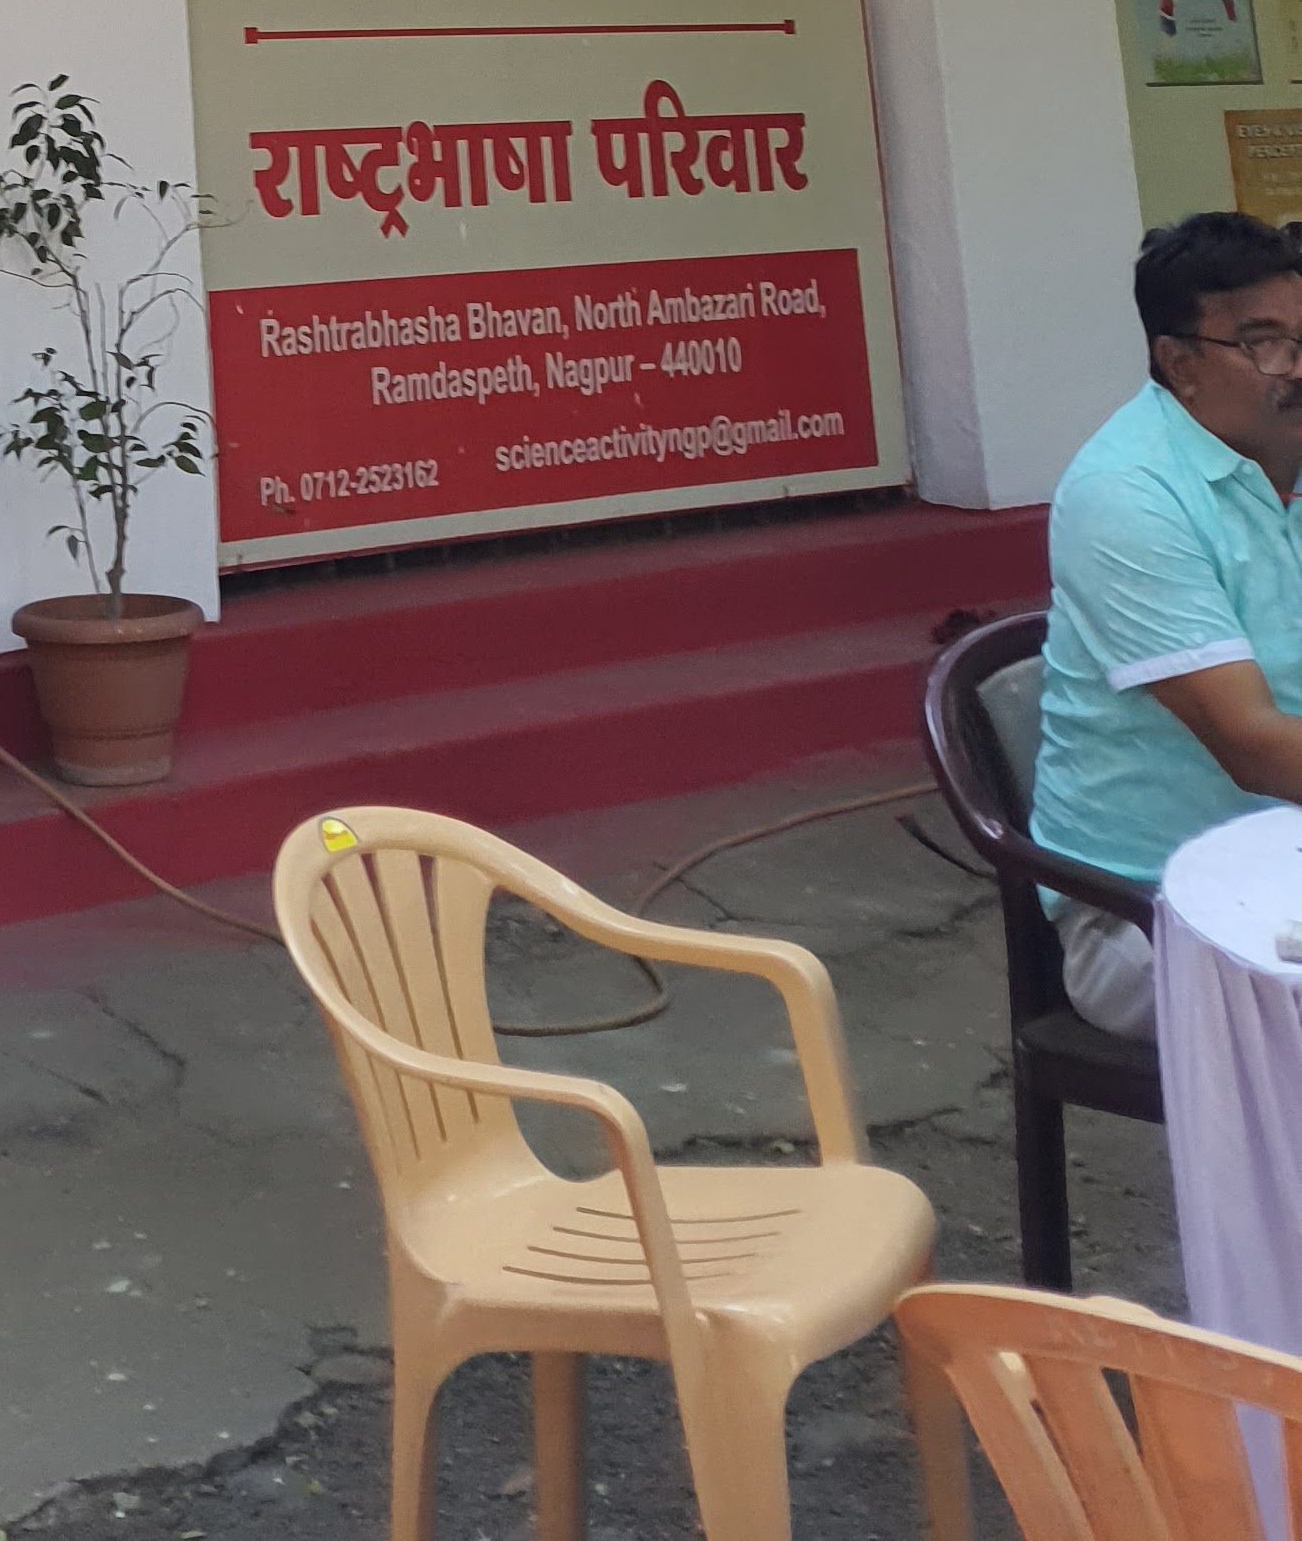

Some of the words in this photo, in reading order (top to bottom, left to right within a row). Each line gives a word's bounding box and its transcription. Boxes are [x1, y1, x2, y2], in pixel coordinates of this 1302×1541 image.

[249, 120, 572, 238] राष्ट्रभाषा
[591, 79, 809, 200] परिवार
[260, 305, 462, 358] Rashtrabhasha
[466, 301, 570, 341] Bhavan,
[574, 291, 642, 331] North
[647, 283, 755, 325] Ambazari
[759, 278, 827, 318] Road,
[371, 354, 541, 406] Ramdaspeth,
[545, 352, 635, 397] Nagpur
[660, 336, 743, 378] 440010
[495, 409, 845, 473] scienceactivityngp@gmail.com
[260, 475, 296, 506] Ph.
[300, 459, 440, 502] 0712-2523162
